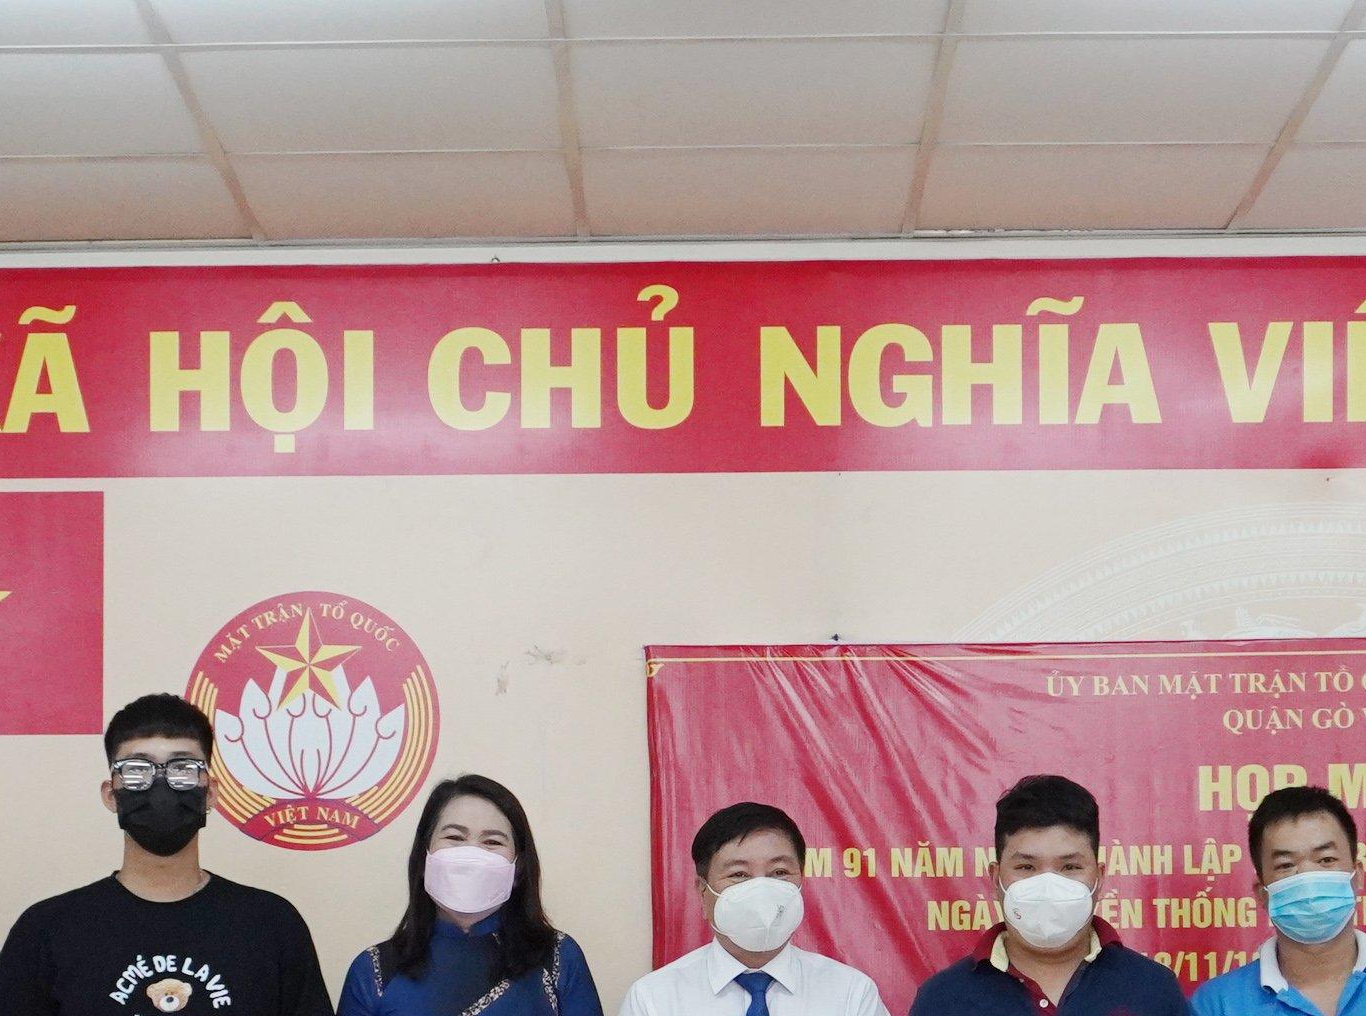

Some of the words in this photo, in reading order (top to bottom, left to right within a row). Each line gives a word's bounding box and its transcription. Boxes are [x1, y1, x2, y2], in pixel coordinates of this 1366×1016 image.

[150, 301, 375, 453] HỘI
[427, 285, 695, 430] CHỦ
[759, 296, 1160, 427] NGHĨA
[214, 625, 251, 663] MẶT
[251, 603, 303, 630] TRẬN
[320, 600, 348, 620] TỔ
[350, 612, 400, 652] QUỐC
[1046, 669, 1084, 697] ỦY
[1092, 674, 1149, 696] BAN
[1158, 670, 1222, 700] MẶT
[1229, 669, 1307, 699] TRẬN
[1315, 665, 1355, 692] TỔ
[1222, 705, 1304, 735] QUẬN
[1312, 702, 1355, 729] GÒ
[264, 805, 309, 826] VIỆT
[317, 807, 361, 829] NAM
[842, 847, 876, 878] 91
[891, 841, 964, 877] NĂM
[1184, 838, 1242, 881] LẬP
[1152, 887, 1258, 929] THỐNG
[152, 955, 178, 973] DE
[181, 957, 210, 982] LA
[205, 974, 232, 1009] VIE
